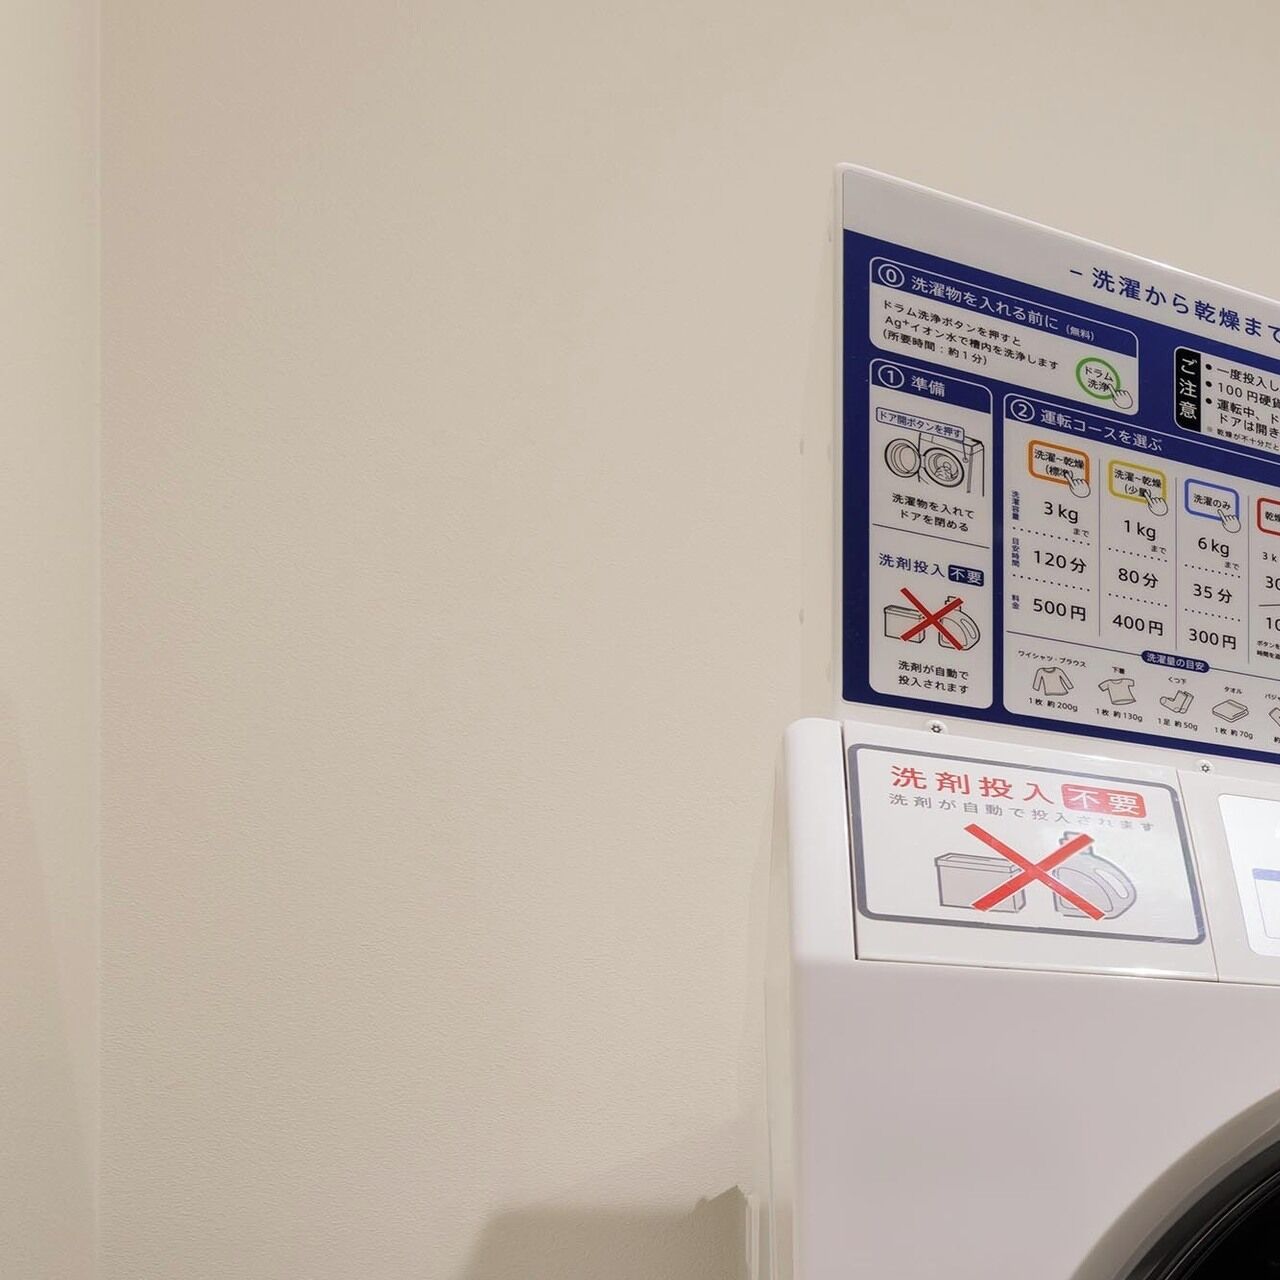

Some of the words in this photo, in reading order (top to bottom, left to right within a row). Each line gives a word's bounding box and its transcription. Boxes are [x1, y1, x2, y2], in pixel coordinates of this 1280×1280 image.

[911, 275, 1059, 330] 洗濯物を入れる前に
[883, 300, 1022, 347] ドラム洗浄ボタンを押すと
[911, 375, 945, 398] 準備
[1084, 366, 1114, 382] ドラム
[1178, 358, 1198, 420] ご注意
[878, 410, 962, 438] ドア開ボタンを押す
[1040, 408, 1163, 452] 運転コースを選ぶ
[891, 493, 975, 520] 洗濯物を入れて
[1193, 492, 1231, 511] 洗濯のみ
[899, 509, 970, 532] ドアを閉める
[878, 552, 946, 578] 洗剤投入
[949, 566, 985, 586] 不要
[897, 659, 970, 681] 洗剤が自動で
[1146, 652, 1206, 672] 洗濯量の目安
[898, 675, 970, 695] 投入されます
[891, 765, 1055, 805] 洗剤投入
[1071, 789, 1141, 815] 不要
